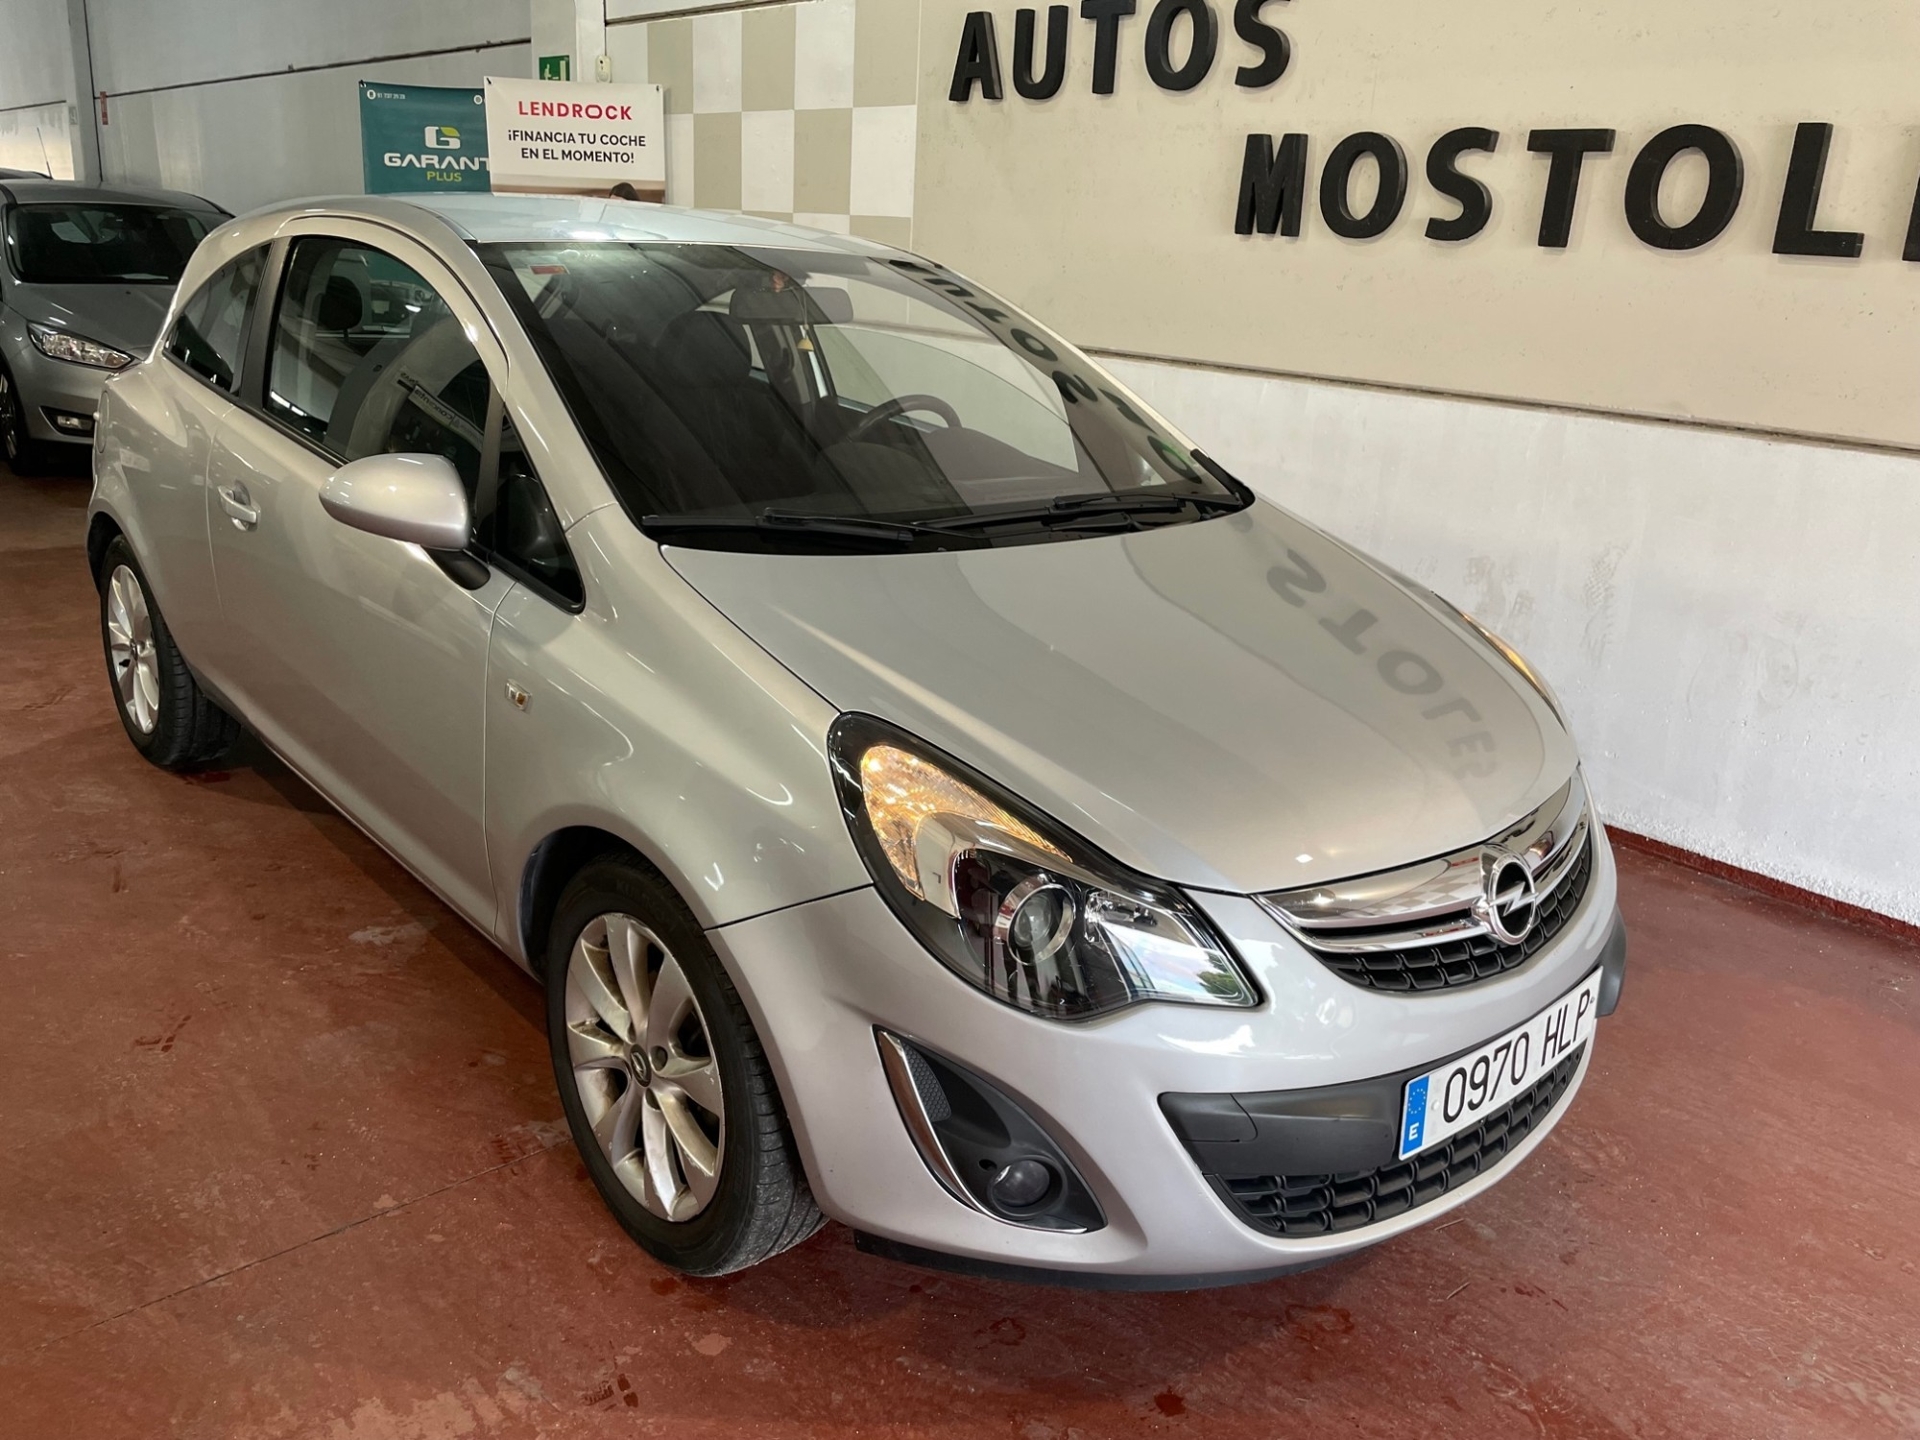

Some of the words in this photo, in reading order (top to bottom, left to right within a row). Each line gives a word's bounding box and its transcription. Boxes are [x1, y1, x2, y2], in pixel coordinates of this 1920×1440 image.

[949, 0, 1292, 103] AUTOS
[518, 100, 632, 121] LENDROCK
[508, 129, 577, 144] ¡FINANCIA
[578, 133, 597, 145] TU
[599, 134, 646, 147] COCHE
[521, 147, 539, 159] EN
[543, 149, 559, 160] EL
[561, 149, 635, 164] MOMENTO!
[426, 171, 463, 182] PLUS
[1234, 122, 1920, 262] MOSTOL
[1442, 1031, 1530, 1124] 0970
[1541, 988, 1591, 1067] HLP
[1408, 1122, 1420, 1142] E
